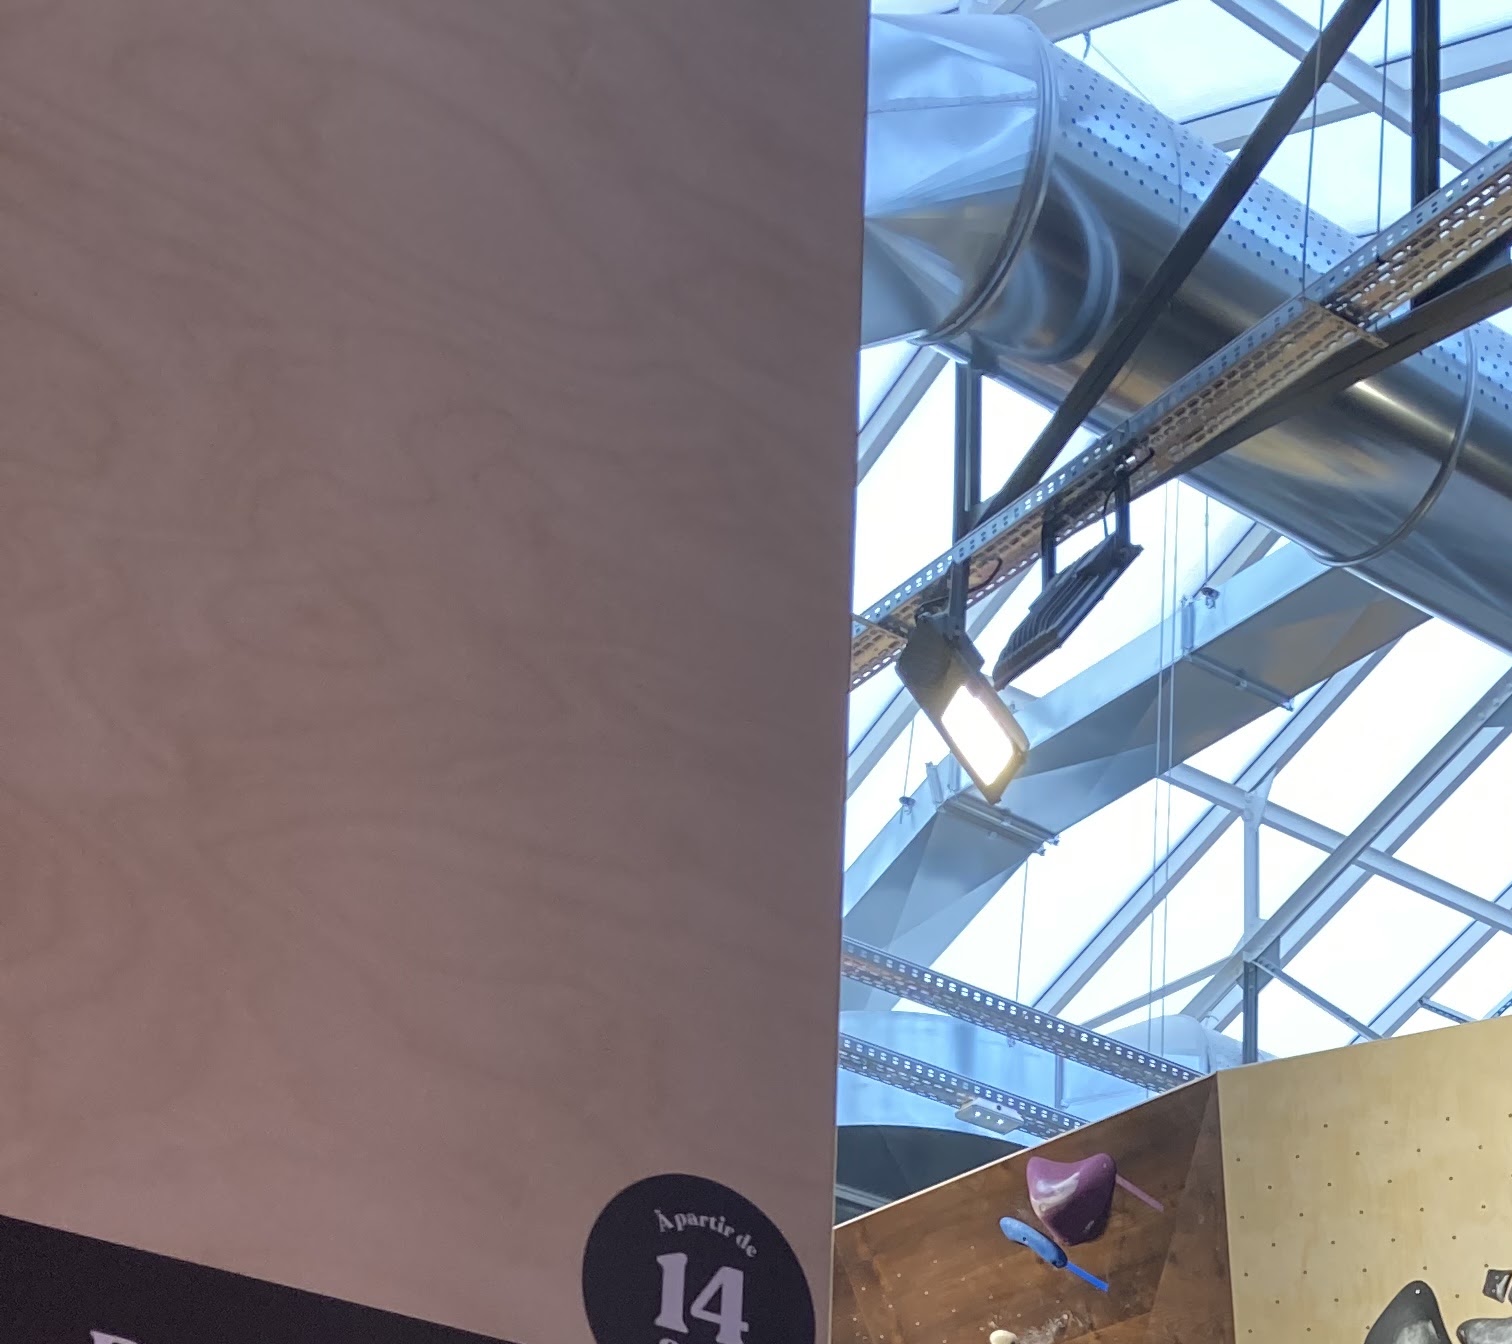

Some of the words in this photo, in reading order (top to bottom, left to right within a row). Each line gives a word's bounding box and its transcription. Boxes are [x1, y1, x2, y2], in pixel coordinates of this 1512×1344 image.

[653, 1207, 675, 1233] À
[674, 1211, 735, 1239] partir
[735, 1233, 758, 1258] de
